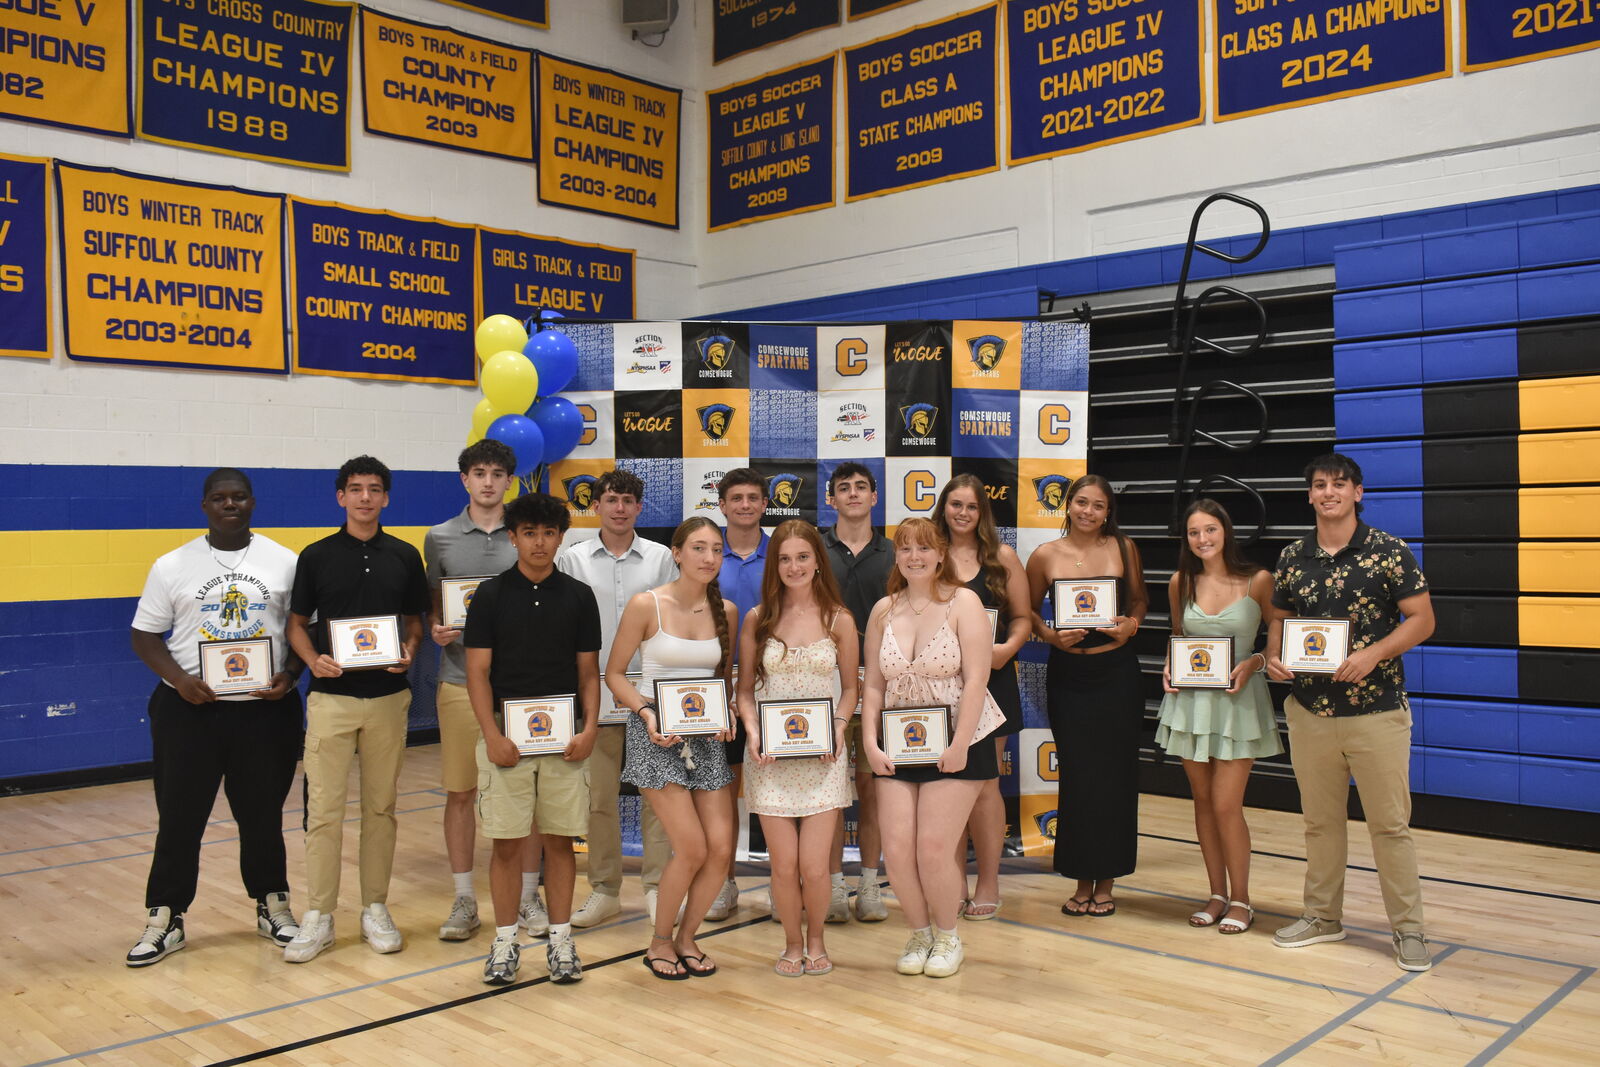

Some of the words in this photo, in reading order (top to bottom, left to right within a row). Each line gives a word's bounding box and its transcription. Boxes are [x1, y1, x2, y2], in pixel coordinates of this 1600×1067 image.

[207, 0, 262, 23] CROSS
[272, 10, 344, 41] COUNTRY
[752, 1, 797, 29] 1974
[1024, 0, 1078, 33] BOYS
[0, 26, 105, 72] PIONS
[155, 17, 283, 69] LEAGUE
[300, 50, 335, 77] IV
[378, 26, 414, 47] BOYS
[421, 36, 465, 59] TRACK
[470, 50, 477, 63] &
[481, 51, 517, 72] FIELD
[1038, 20, 1126, 65] LEAGUE
[1136, 10, 1163, 40] IV
[1221, 22, 1283, 59] CLASS
[1291, 14, 1318, 44] AA
[403, 56, 496, 92] COUNTY
[858, 53, 903, 82] BOYS
[909, 30, 982, 65] SOCCER
[1281, 44, 1373, 88] 2024
[0, 71, 44, 99] 82
[152, 57, 339, 115] CHAMPIONS
[881, 77, 938, 109] CLASS
[945, 72, 957, 92] A
[1040, 49, 1163, 102] CHAMPIONS
[383, 79, 515, 123] CHAMPIONS
[553, 73, 581, 96] BOYS
[587, 83, 625, 107] WINTER
[632, 95, 666, 118] TRACK
[720, 93, 757, 116] BOYS
[762, 73, 822, 103] SOCCER
[207, 109, 288, 141] 1988
[426, 115, 478, 138] 2003
[555, 103, 635, 142] LEAGUE
[643, 126, 664, 148] IV
[733, 106, 790, 138] LEAGUE
[796, 102, 806, 120] V
[859, 124, 900, 148] STATE
[905, 101, 983, 136] CHAMPIONS
[1041, 88, 1165, 139] 2021-2022
[770, 140, 777, 153] &
[780, 131, 795, 151] LONG
[799, 124, 820, 146] ISLAND
[554, 137, 663, 180] CHAMPIONS
[729, 155, 811, 189] CHAMPIONS
[896, 147, 943, 172] 2009
[560, 173, 657, 209] 2003-2004
[747, 187, 788, 208] 2009
[83, 190, 129, 216] BOYS
[141, 198, 201, 227] WINTER
[212, 208, 264, 235] TRACK
[84, 230, 177, 265] SUFFOLK
[188, 243, 263, 274] COUNTY
[312, 223, 350, 247] BOYS
[357, 230, 404, 255] TRACK
[409, 242, 417, 257] &
[421, 239, 460, 262] FIELD
[323, 262, 382, 287] SMALL
[389, 271, 450, 296] SCHOOL
[492, 248, 527, 270] GIRLS
[533, 254, 572, 277] TRACK
[577, 263, 585, 278] &
[590, 262, 622, 282] FIELD
[87, 273, 263, 314] CHAMPIONS
[514, 283, 586, 312] LEAGUE
[591, 293, 603, 313] V
[305, 296, 373, 322] COUNTY
[382, 305, 467, 332] CHAMPIONS
[106, 318, 252, 349] 2003-2004
[635, 334, 662, 344] SECTION
[758, 345, 809, 357] COMSEWOGUE
[361, 342, 416, 362] 2004
[757, 354, 809, 370] SPARTANS
[836, 338, 868, 377] C
[699, 370, 732, 378] COMSEWOGUE
[840, 403, 867, 412] SECTION
[960, 411, 1011, 422] COMSEWOGUE
[1038, 403, 1071, 445] C
[902, 437, 936, 446] COMSEWOGUE
[960, 421, 1012, 436] SPARTANS
[703, 471, 727, 480] SECTIO
[904, 470, 936, 511] C
[983, 485, 1010, 500] GUE
[765, 507, 800, 516] COMSEWOGUE
[195, 576, 223, 601] LEAGUE
[232, 573, 271, 601] CHAMPIONS
[200, 604, 221, 612] 20
[202, 618, 264, 640] COMSEWOGUE
